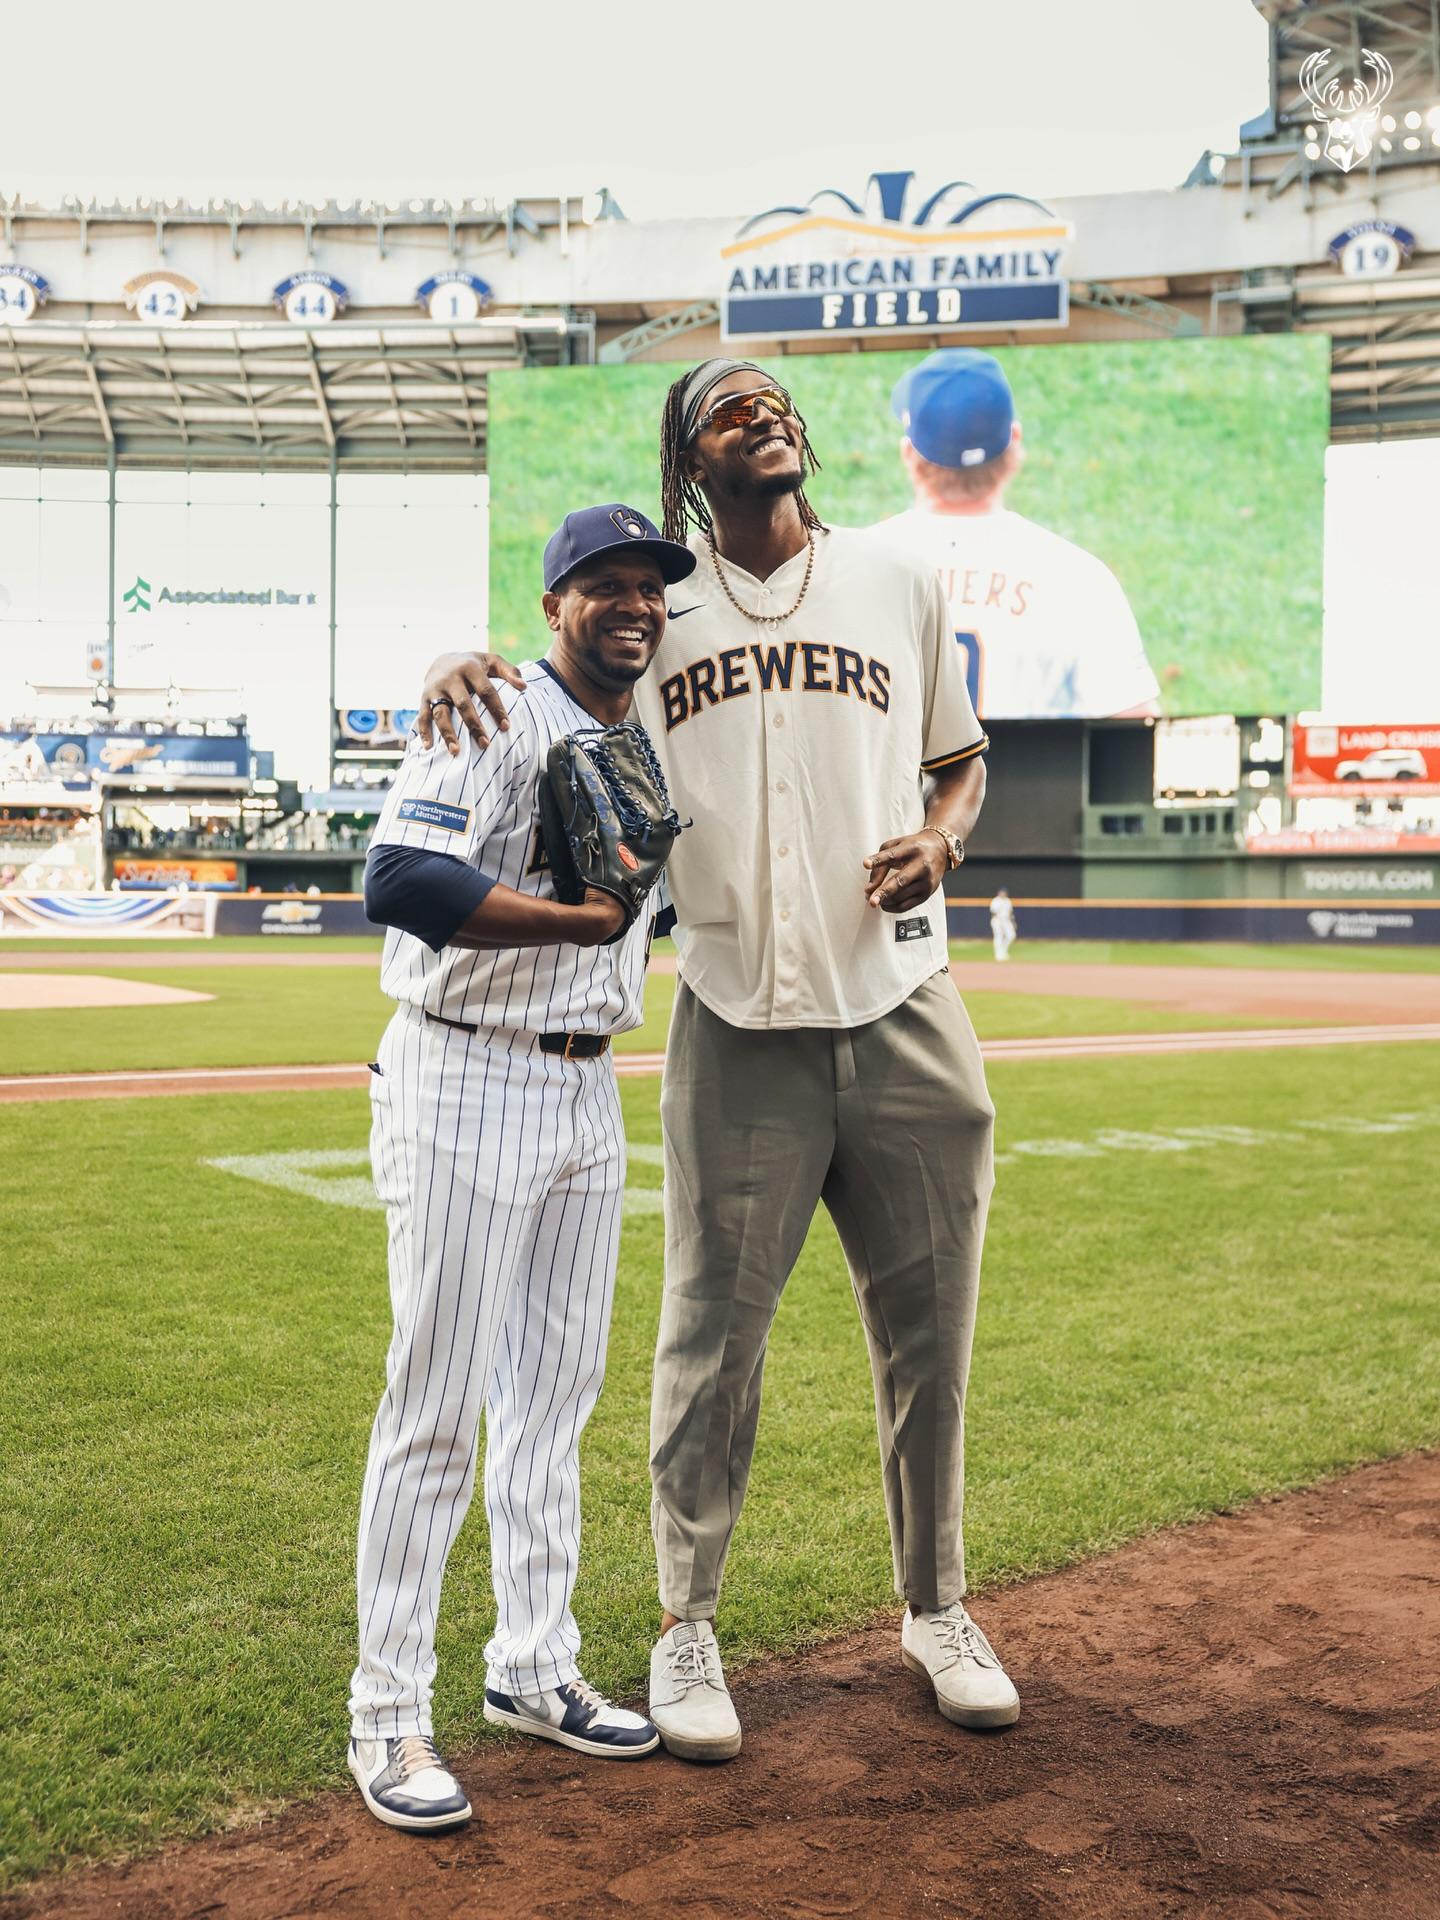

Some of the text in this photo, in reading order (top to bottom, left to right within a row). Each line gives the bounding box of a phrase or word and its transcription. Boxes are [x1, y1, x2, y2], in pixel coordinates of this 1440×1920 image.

[729, 249, 1062, 292] AMERICAN FAMILY
[1356, 246, 1389, 272] 19
[144, 293, 178, 316] 42
[294, 295, 327, 317] 44
[449, 296, 458, 317] 1
[822, 288, 961, 328] FIELD
[659, 640, 892, 736] BREWERS
[415, 811, 442, 822] Mutual
[416, 804, 467, 821] Northwestern
[1304, 869, 1434, 892] TOYOTA.COM
